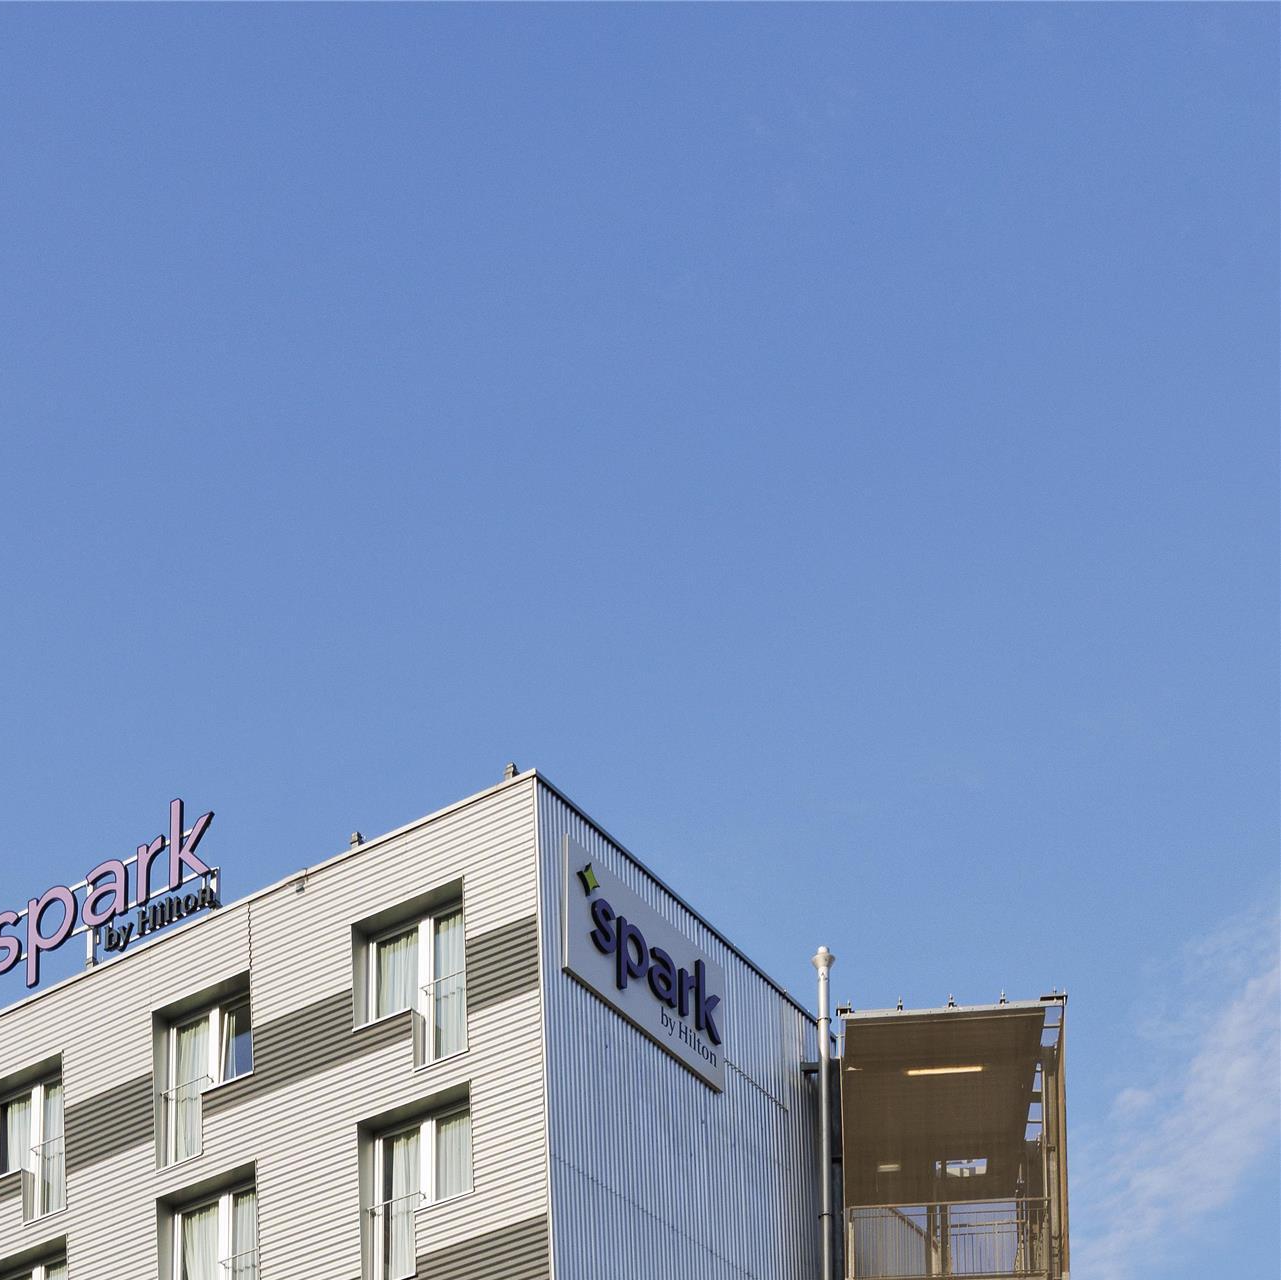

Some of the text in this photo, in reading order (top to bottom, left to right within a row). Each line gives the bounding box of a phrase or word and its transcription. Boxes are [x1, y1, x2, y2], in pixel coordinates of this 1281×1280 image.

[104, 884, 217, 952] by Hilton
[590, 898, 722, 1046] spark
[661, 1006, 717, 1068] by Hilton
